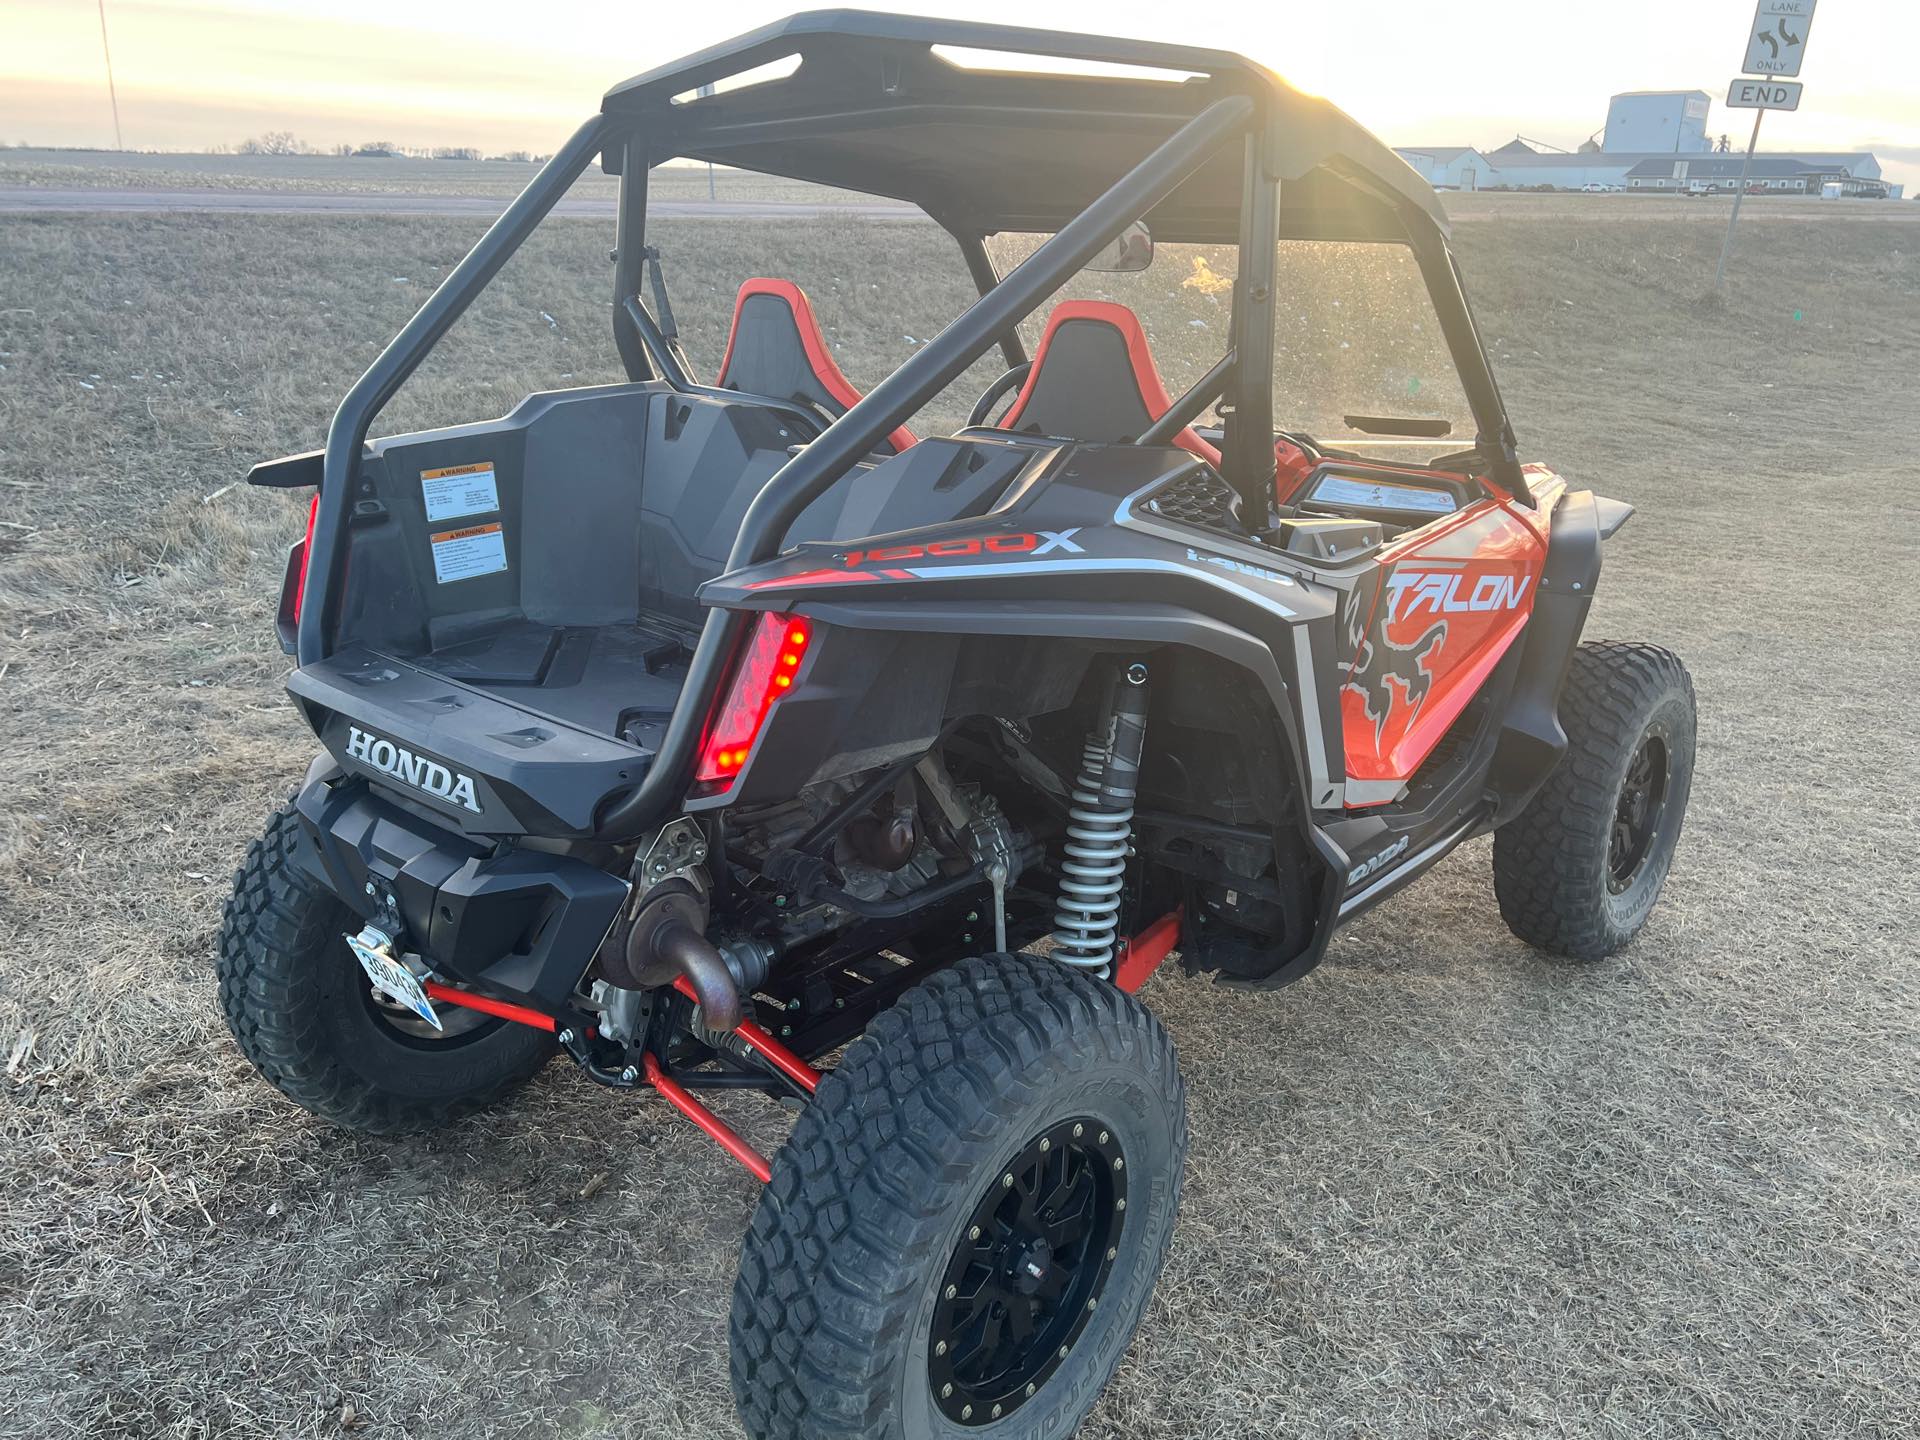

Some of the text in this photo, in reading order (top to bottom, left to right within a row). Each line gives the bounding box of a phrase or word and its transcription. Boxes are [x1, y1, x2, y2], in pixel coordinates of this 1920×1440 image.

[1771, 2, 1801, 12] LANE
[1757, 60, 1788, 72] ONLY
[1740, 86, 1788, 104] END
[445, 466, 477, 477] WARNING
[454, 527, 486, 539] WARNING
[1386, 573, 1532, 624] TALON
[345, 726, 483, 814] HONDA
